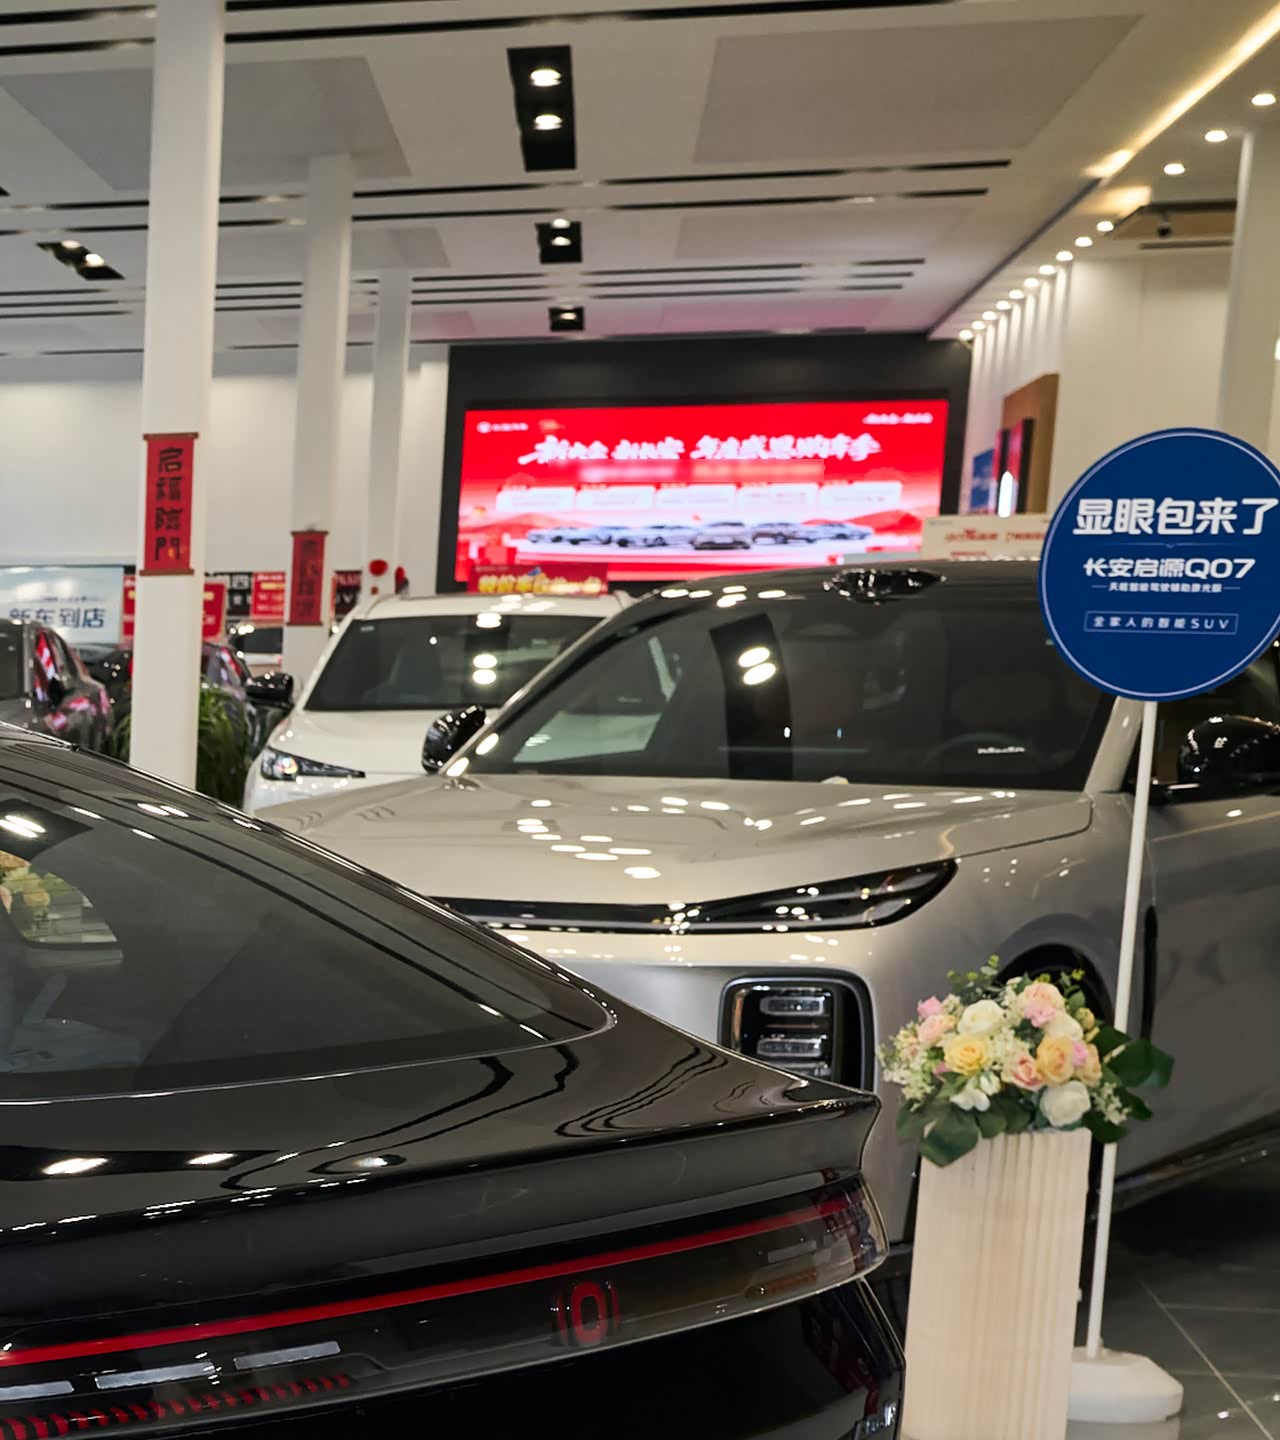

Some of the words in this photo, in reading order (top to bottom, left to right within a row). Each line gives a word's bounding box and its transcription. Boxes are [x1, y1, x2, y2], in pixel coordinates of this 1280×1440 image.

[1072, 497, 1280, 536] 显眼包来了
[1083, 557, 1257, 579] 长安启源Q07
